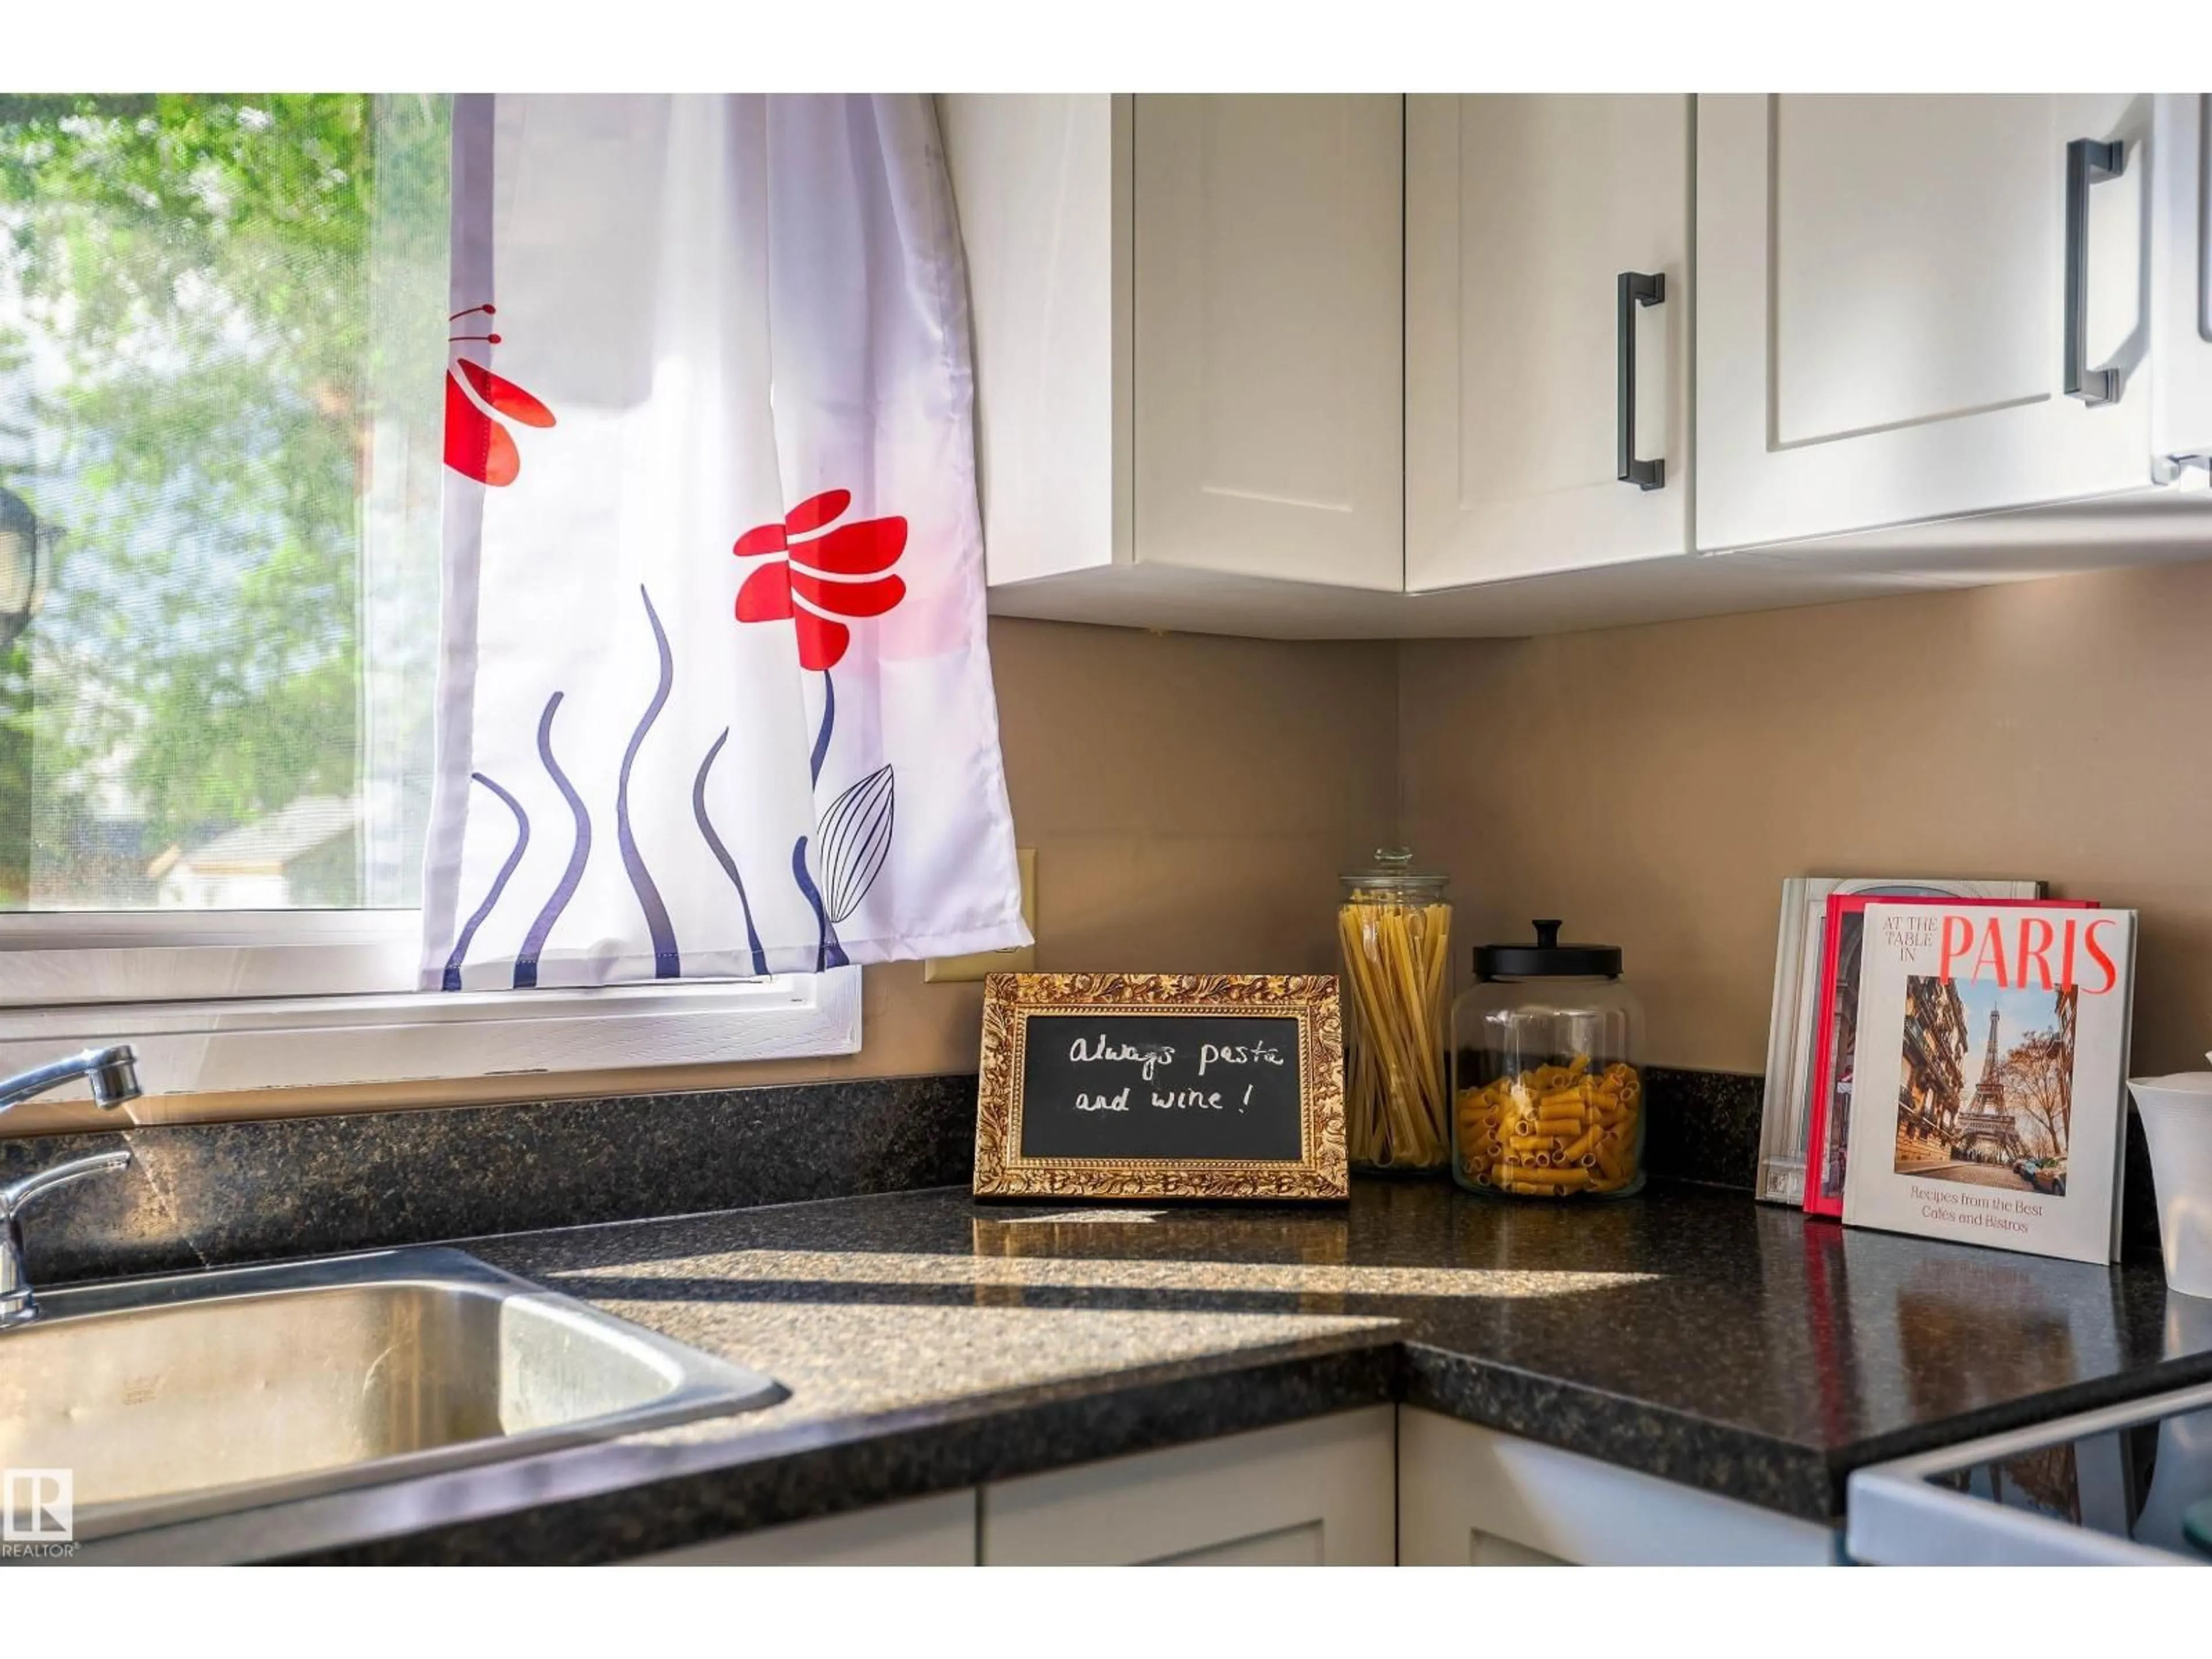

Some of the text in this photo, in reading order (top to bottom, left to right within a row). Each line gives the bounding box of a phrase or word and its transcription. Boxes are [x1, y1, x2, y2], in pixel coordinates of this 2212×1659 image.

[1883, 916, 1937, 931] AT THE
[1886, 931, 1933, 947] TABLE
[1900, 946, 1916, 962] IN
[1939, 915, 2116, 995] PARIS
[1198, 1040, 1284, 1075] pasta
[1076, 1088, 1130, 1111] and
[1911, 1185, 2044, 1216] Recipes from the Best
[1959, 1213, 1983, 1226] and
[1985, 1215, 2028, 1233] Bistros
